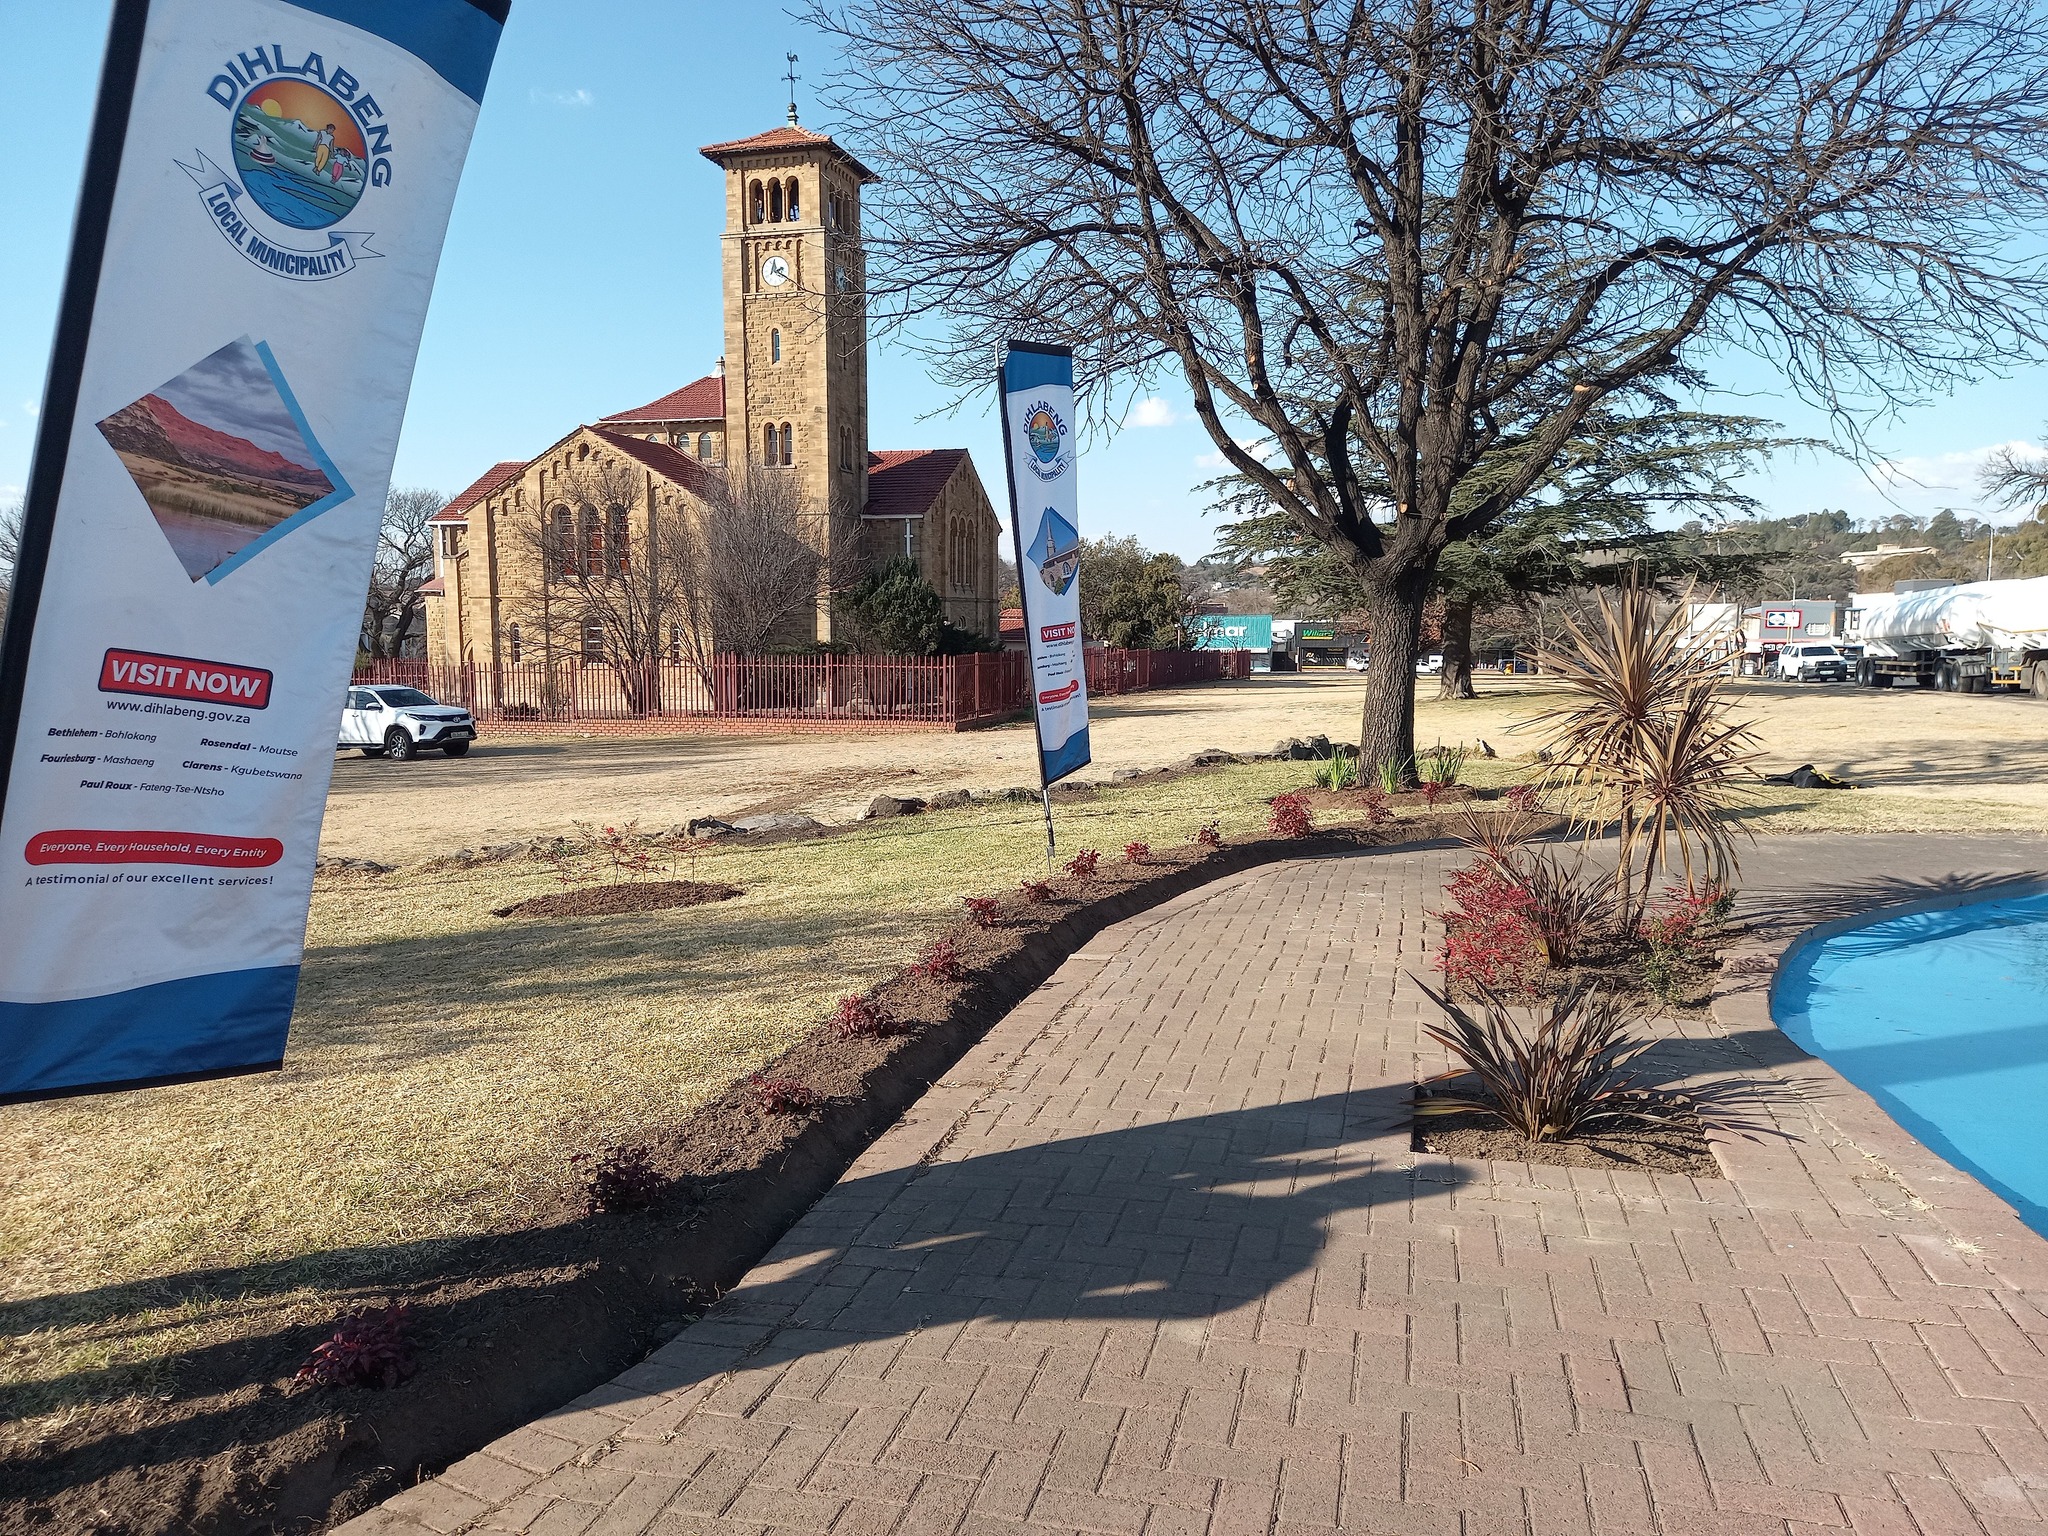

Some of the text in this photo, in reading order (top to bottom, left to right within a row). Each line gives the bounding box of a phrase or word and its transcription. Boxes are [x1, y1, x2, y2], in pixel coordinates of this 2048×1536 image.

[206, 43, 392, 188] DIHLABENG
[207, 192, 346, 276] LOCAL MUNICIPALITY
[1023, 400, 1068, 436] DIHLABENG
[1043, 627, 1065, 639] VISIT
[112, 659, 262, 698] VISIT NOW
[106, 700, 251, 724] www.dihlabeng.gov.za
[48, 727, 98, 738] Bethlehem
[105, 729, 157, 743] Bohlokong
[200, 738, 251, 751] Rosendal
[259, 745, 298, 757] Moutse
[40, 753, 96, 764] Fouriesburg
[103, 755, 155, 768] Mashaeng
[182, 760, 222, 772] Clarens
[231, 764, 303, 780] Kgubetswana
[80, 779, 104, 789] Paul
[105, 781, 132, 790] Roux
[139, 782, 225, 797] Fateng-Tse-Ntsho
[40, 842, 267, 858] Everyone, Every Household, Every Entity
[25, 872, 274, 886] A testimonial of our excellent services!
